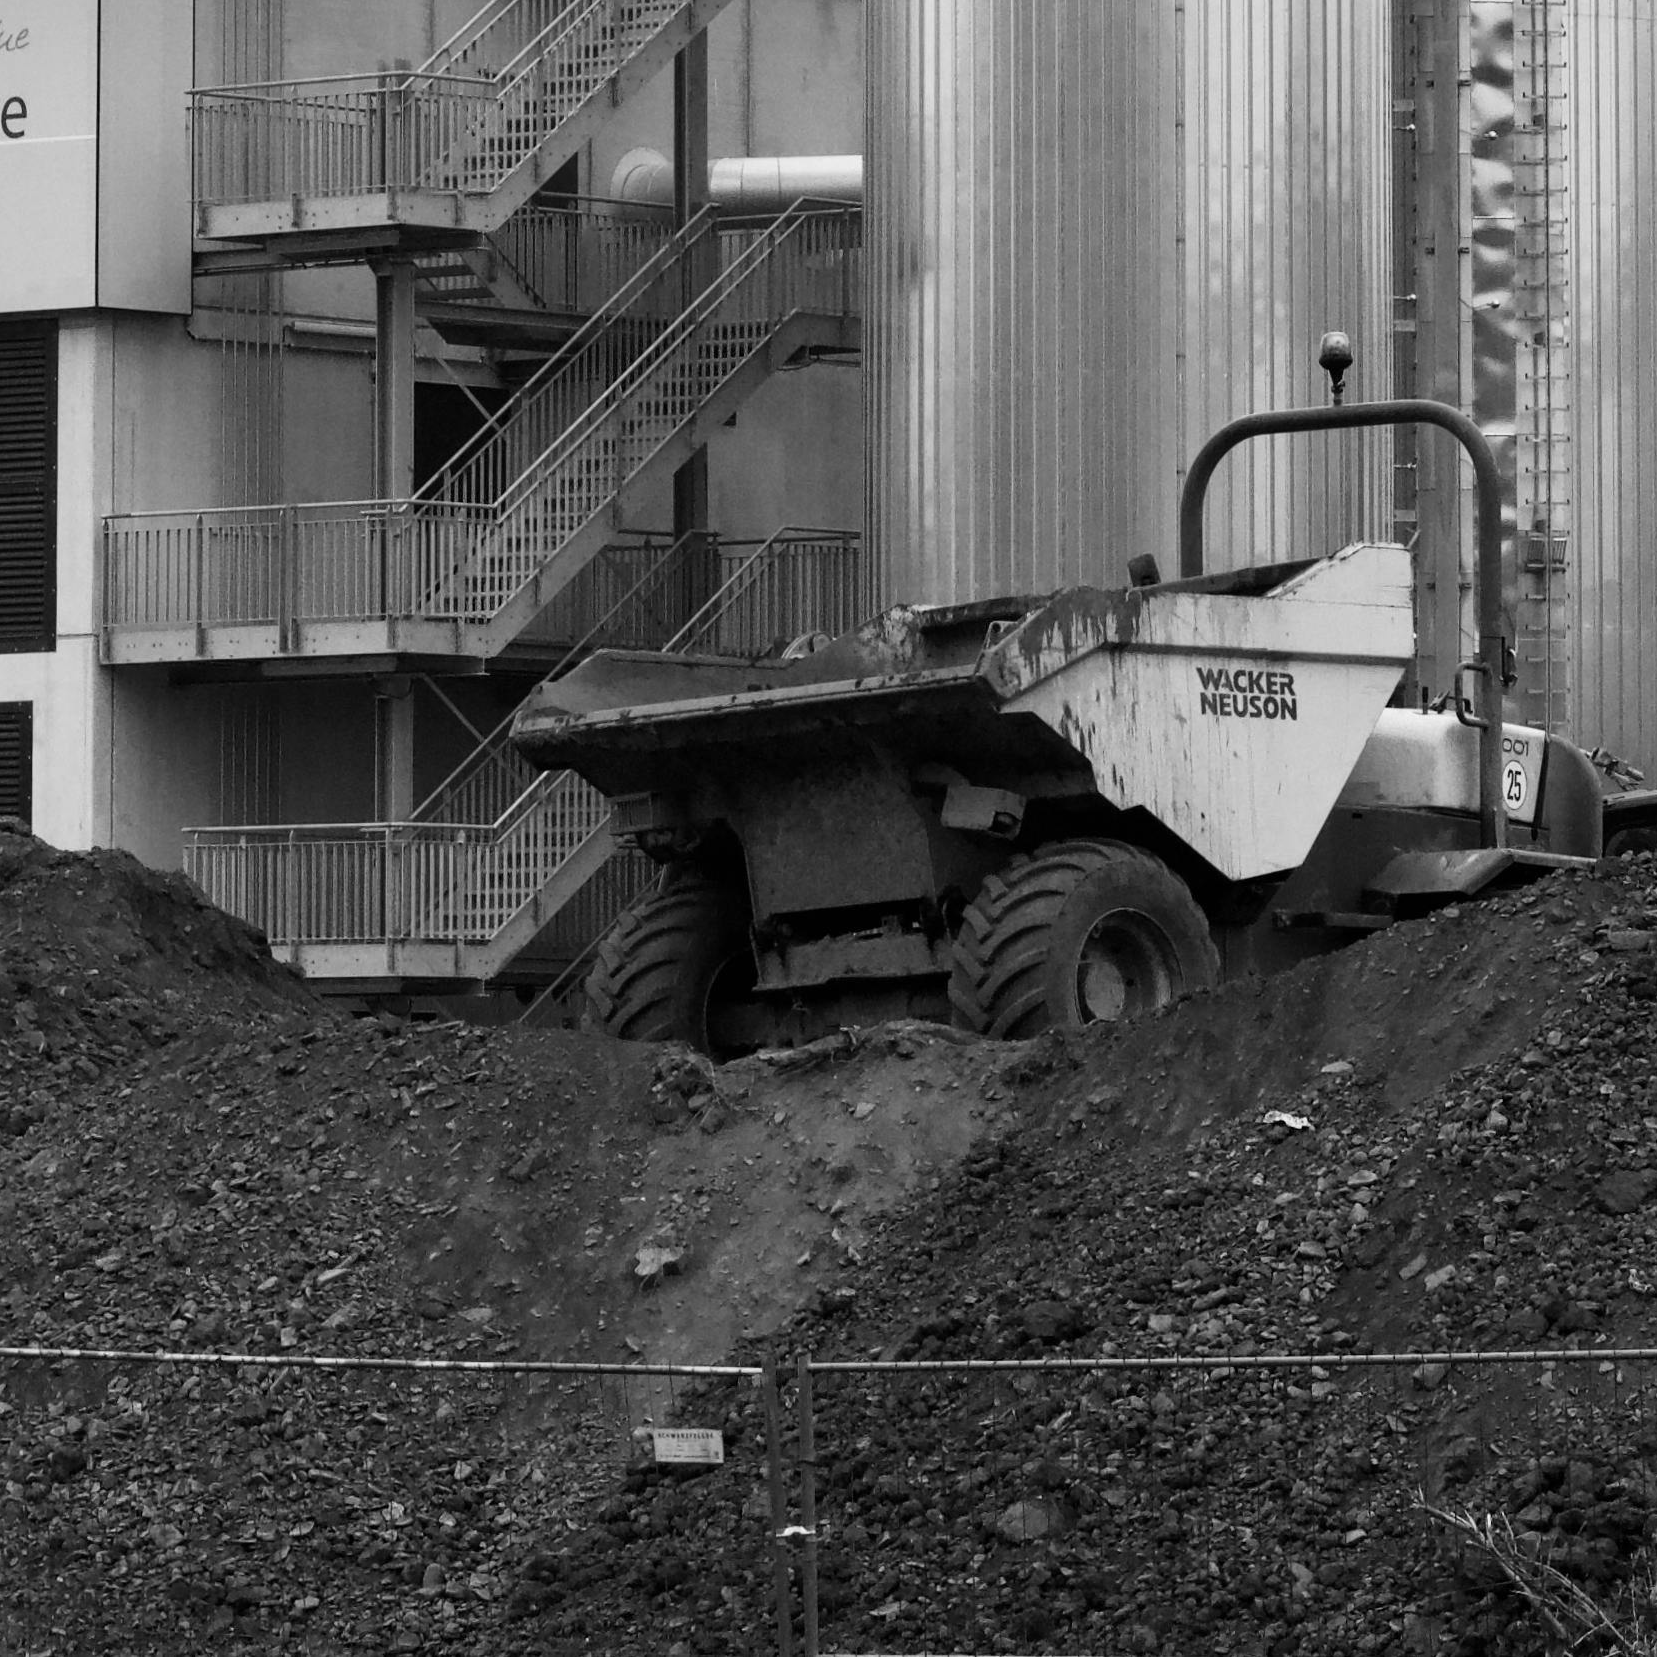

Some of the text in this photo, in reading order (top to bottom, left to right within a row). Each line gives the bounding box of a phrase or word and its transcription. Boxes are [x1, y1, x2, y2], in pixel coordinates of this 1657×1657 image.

[1196, 667, 1296, 696] WACKER
[1200, 692, 1297, 721] NEUSON
[1507, 769, 1522, 802] 25
